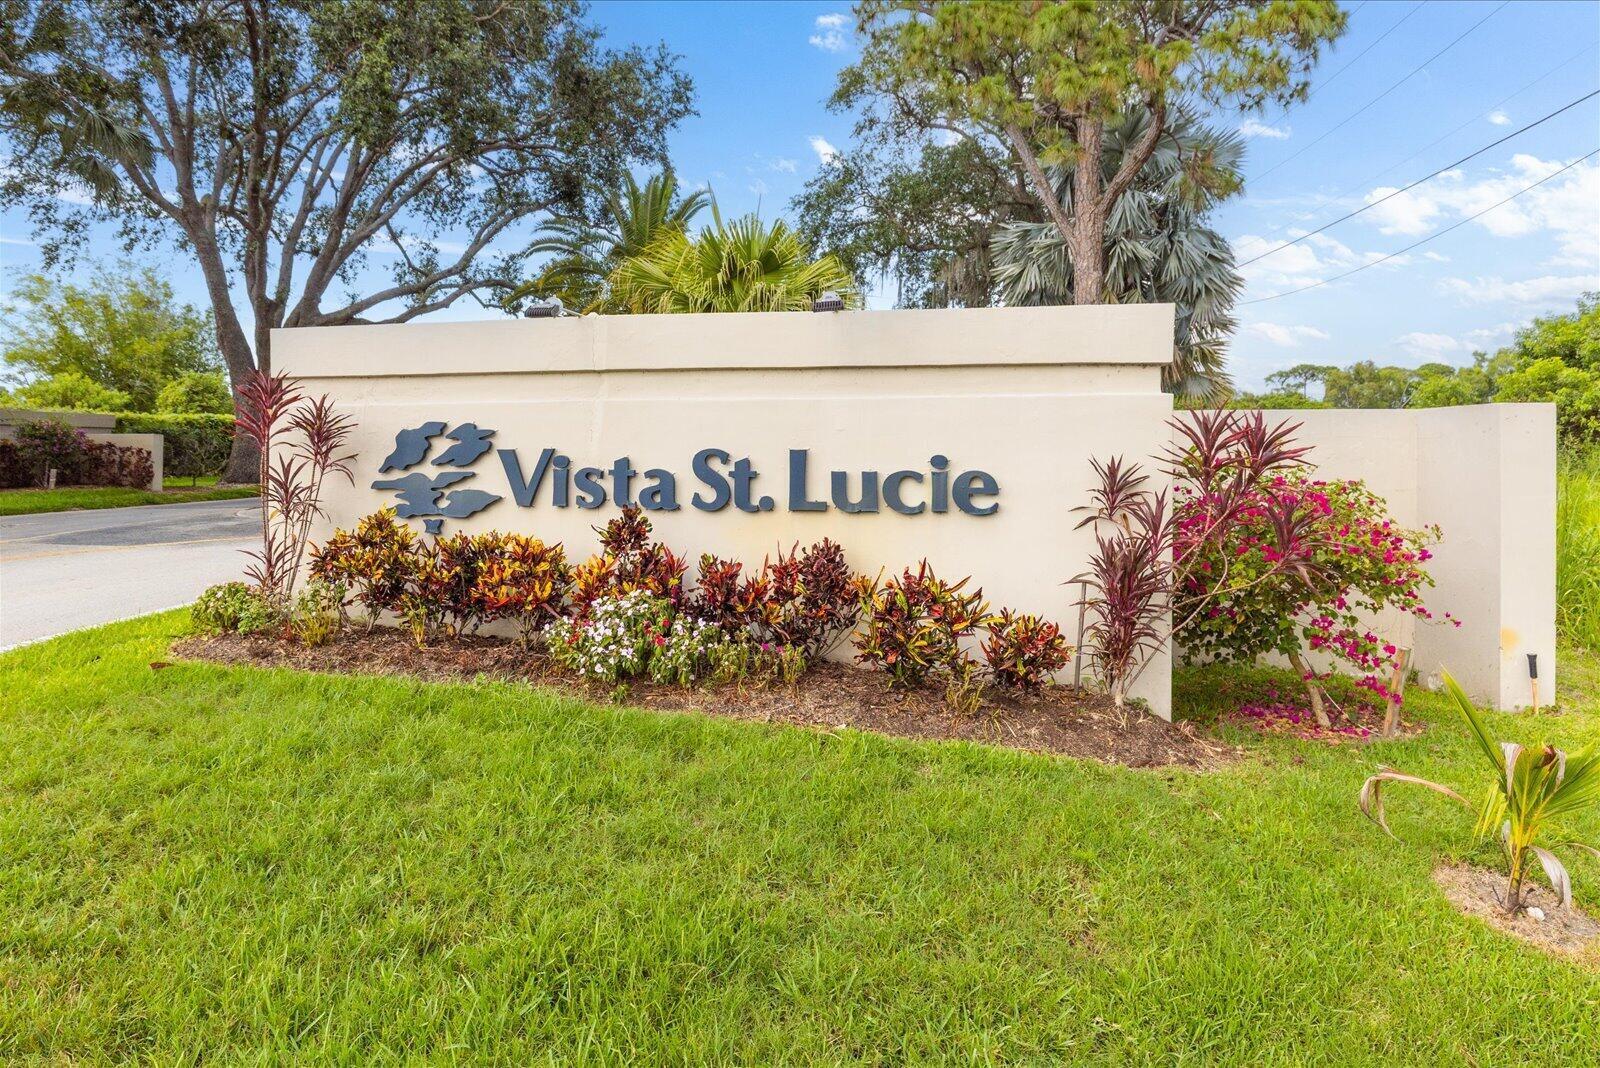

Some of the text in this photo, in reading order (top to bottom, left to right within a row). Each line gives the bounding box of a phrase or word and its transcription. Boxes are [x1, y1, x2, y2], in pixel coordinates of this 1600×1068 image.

[497, 448, 999, 516] Vista St. Lucie
